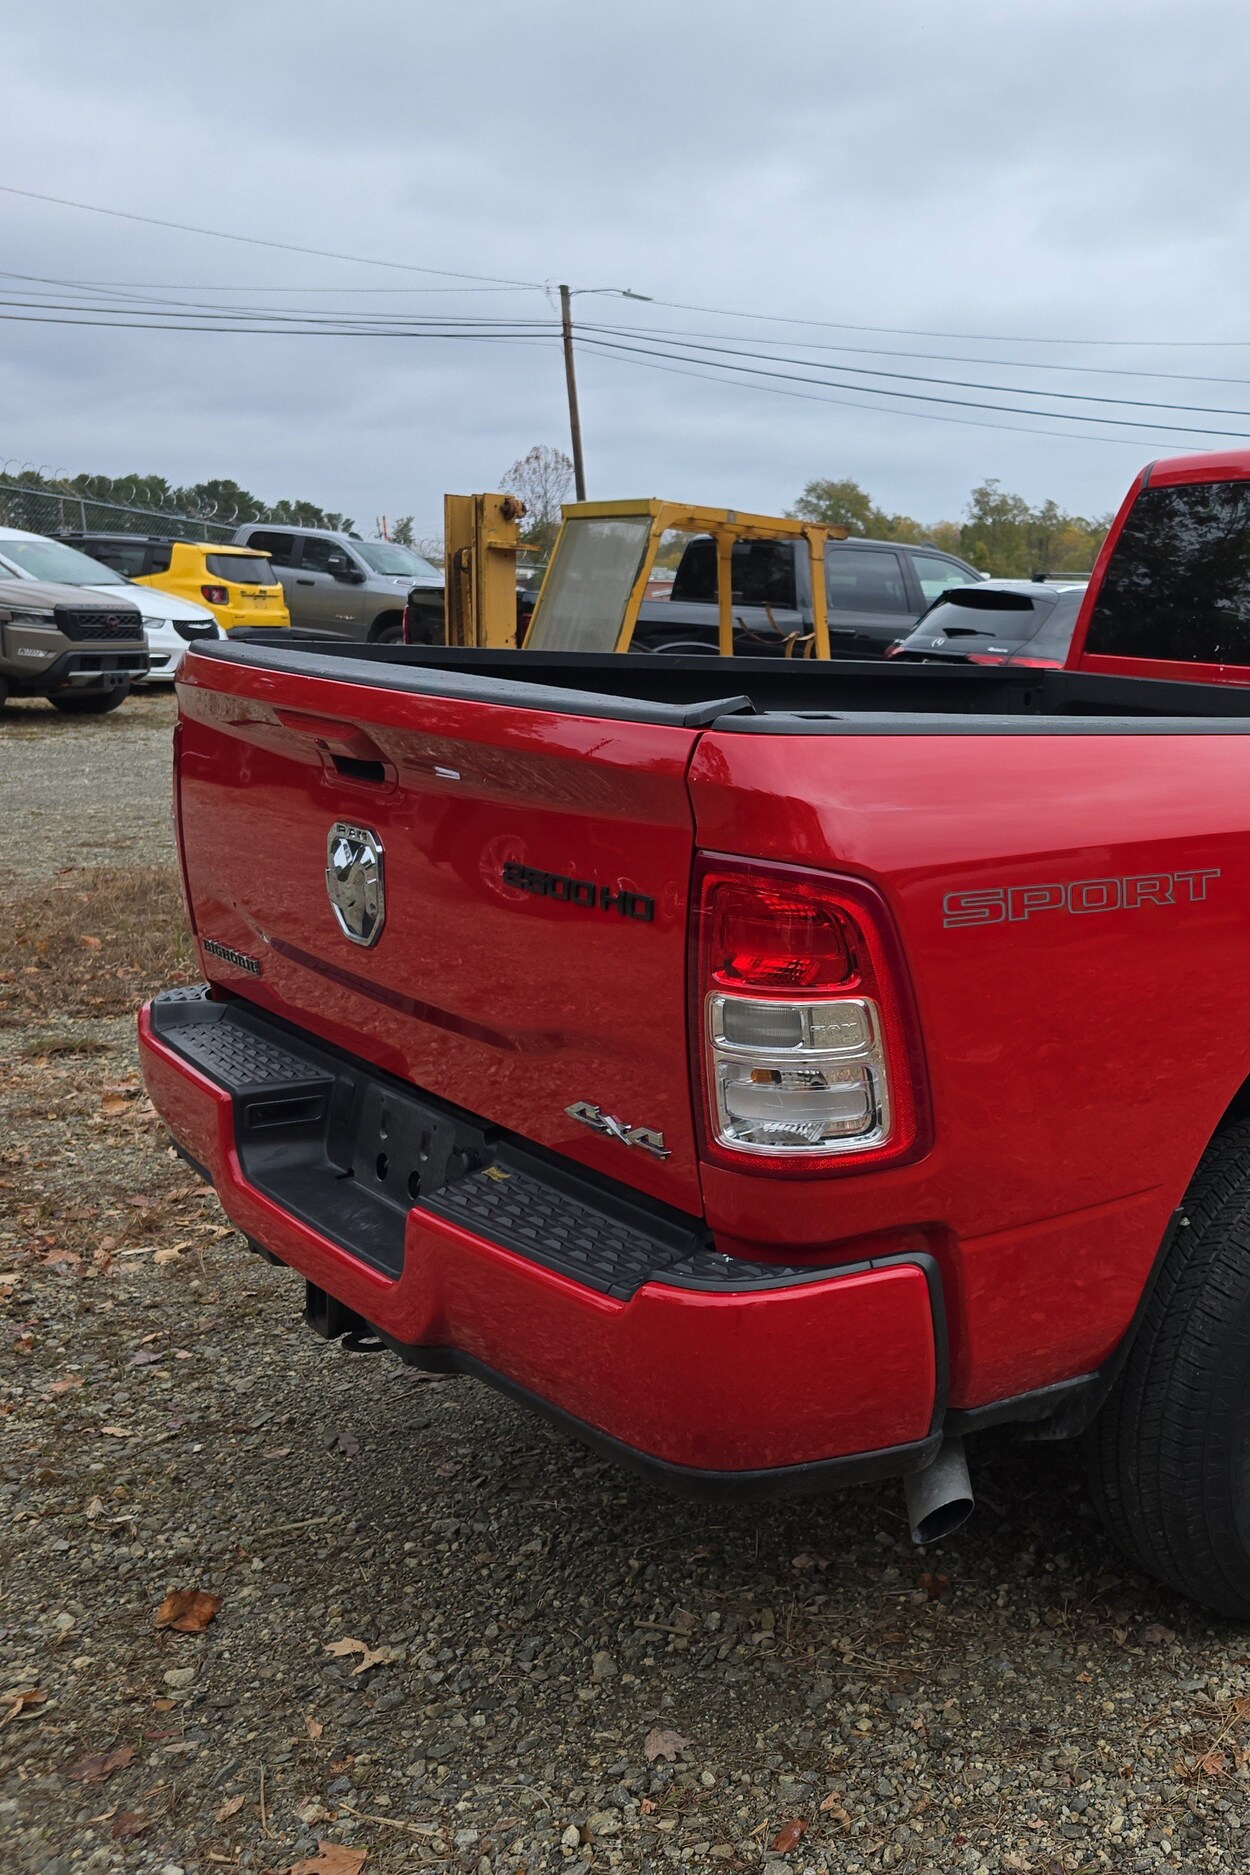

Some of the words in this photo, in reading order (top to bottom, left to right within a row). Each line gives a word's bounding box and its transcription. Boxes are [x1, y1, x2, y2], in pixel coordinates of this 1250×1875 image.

[503, 861, 596, 907] 2500
[600, 886, 655, 922] HD
[943, 868, 1221, 928] SPORT
